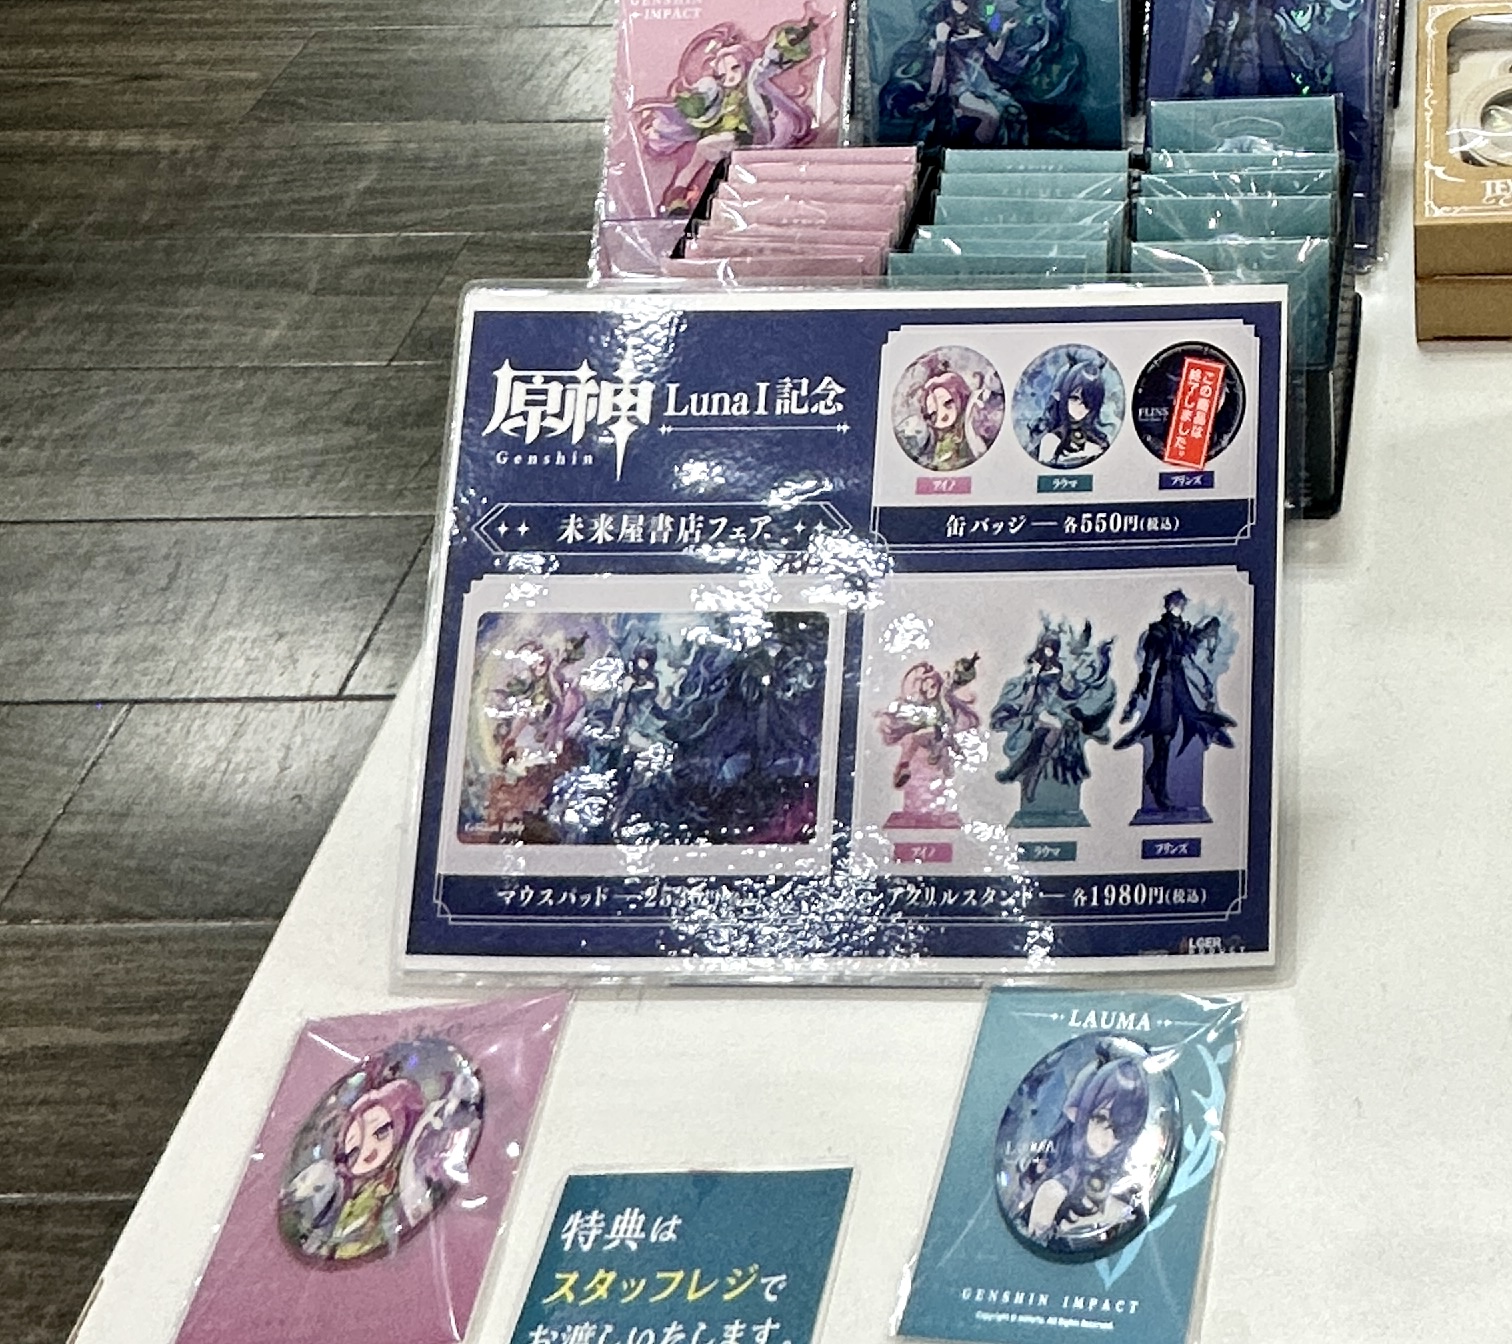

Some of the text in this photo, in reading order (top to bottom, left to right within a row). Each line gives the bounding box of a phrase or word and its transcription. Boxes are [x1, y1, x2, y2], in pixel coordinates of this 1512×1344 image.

[643, 6, 703, 21] IMPACT
[480, 342, 657, 482] 原神
[662, 381, 748, 418] Luna
[775, 375, 847, 417] 記念
[495, 450, 595, 466] Genshin
[556, 513, 773, 545] 未来屋書店フェア
[1068, 1008, 1152, 1032] LAUMA
[561, 1209, 683, 1253] 特典は
[540, 1263, 788, 1307] スタッフレジで
[961, 1286, 1141, 1313] GENSHIN IMPACT
